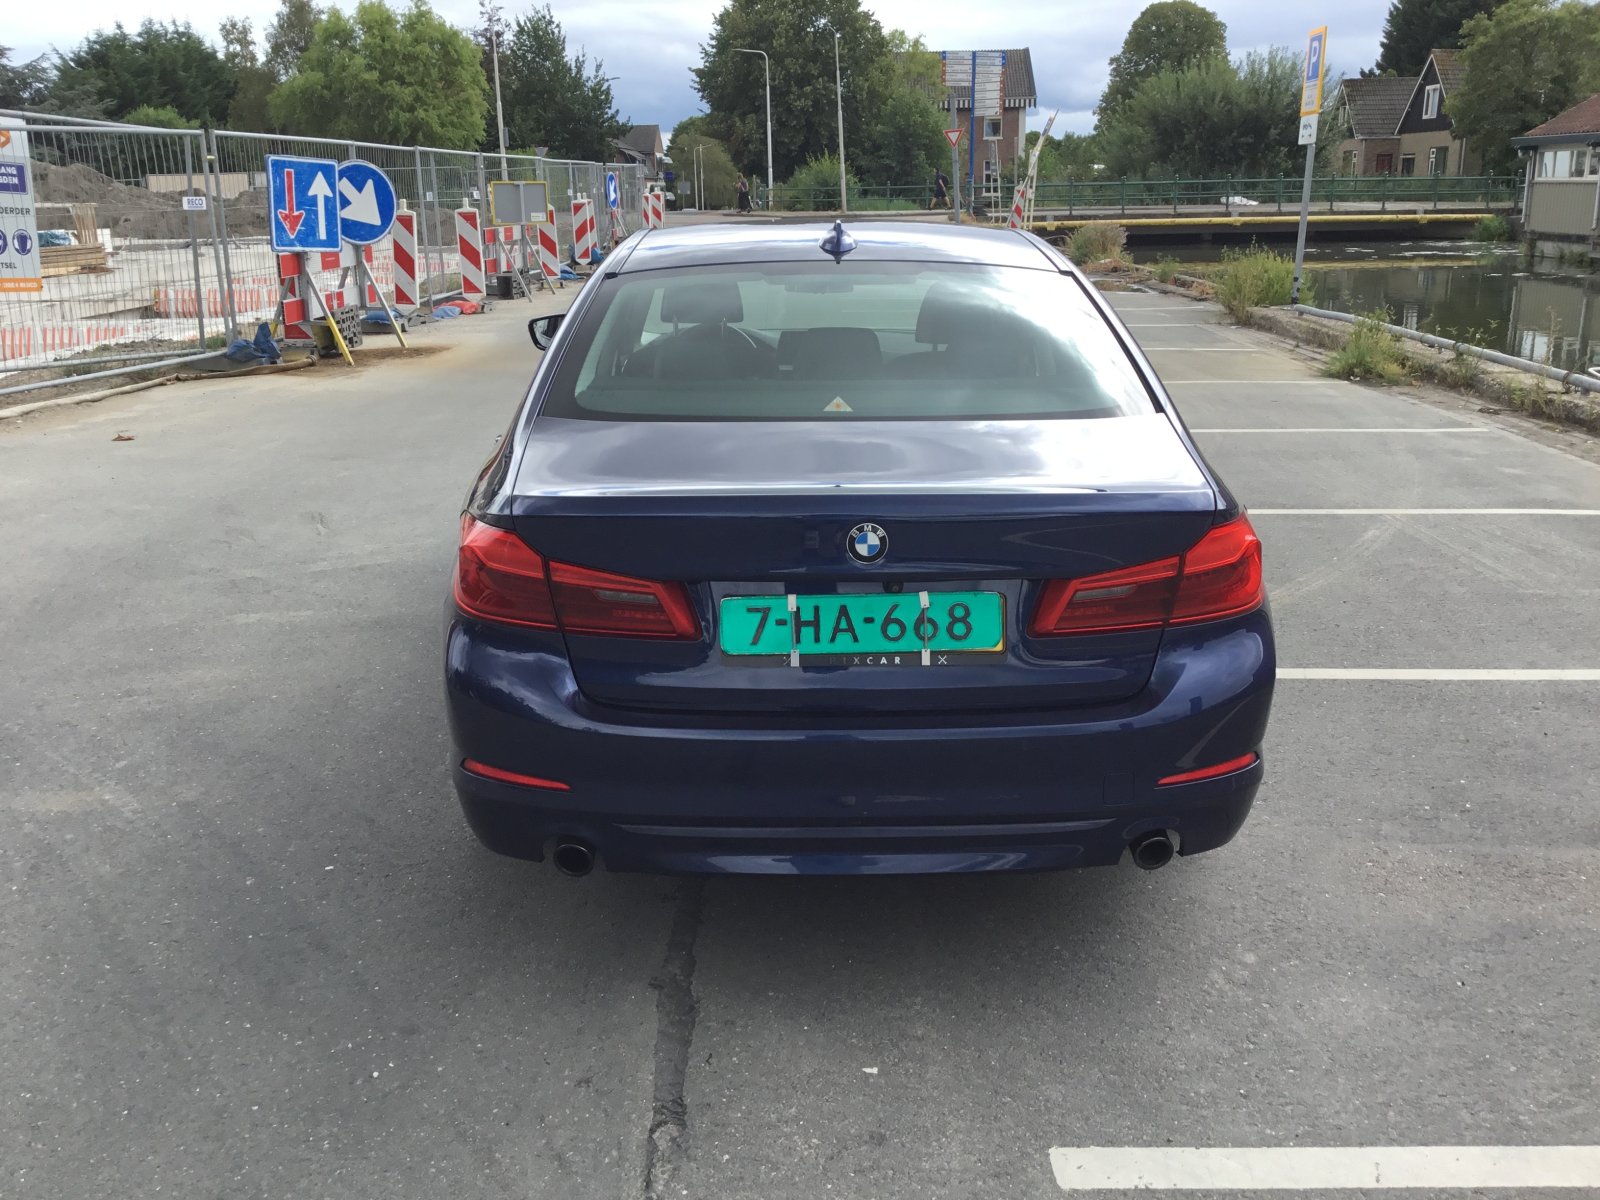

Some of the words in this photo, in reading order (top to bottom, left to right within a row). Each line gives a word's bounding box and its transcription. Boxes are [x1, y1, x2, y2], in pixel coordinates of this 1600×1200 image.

[1309, 40, 1319, 76] P
[851, 524, 885, 538] BMW
[746, 603, 973, 646] 7-HA-668
